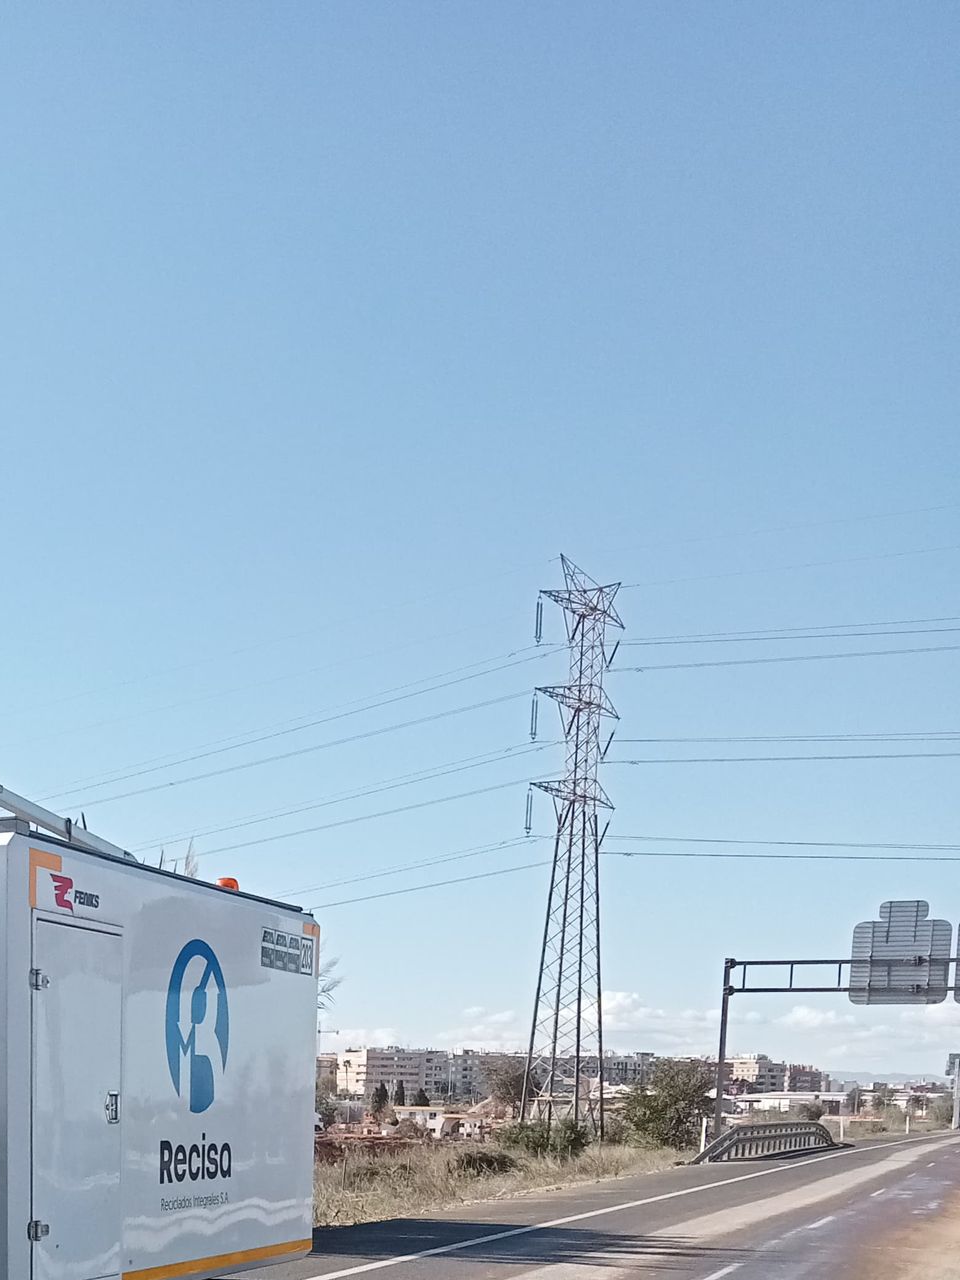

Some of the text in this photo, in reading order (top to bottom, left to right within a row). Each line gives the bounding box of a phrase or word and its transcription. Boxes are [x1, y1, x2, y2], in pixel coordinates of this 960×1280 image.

[74, 890, 100, 908] FENIKS
[302, 943, 312, 970] 203
[159, 1132, 232, 1185] Recisa
[160, 1196, 192, 1211] Reciclados
